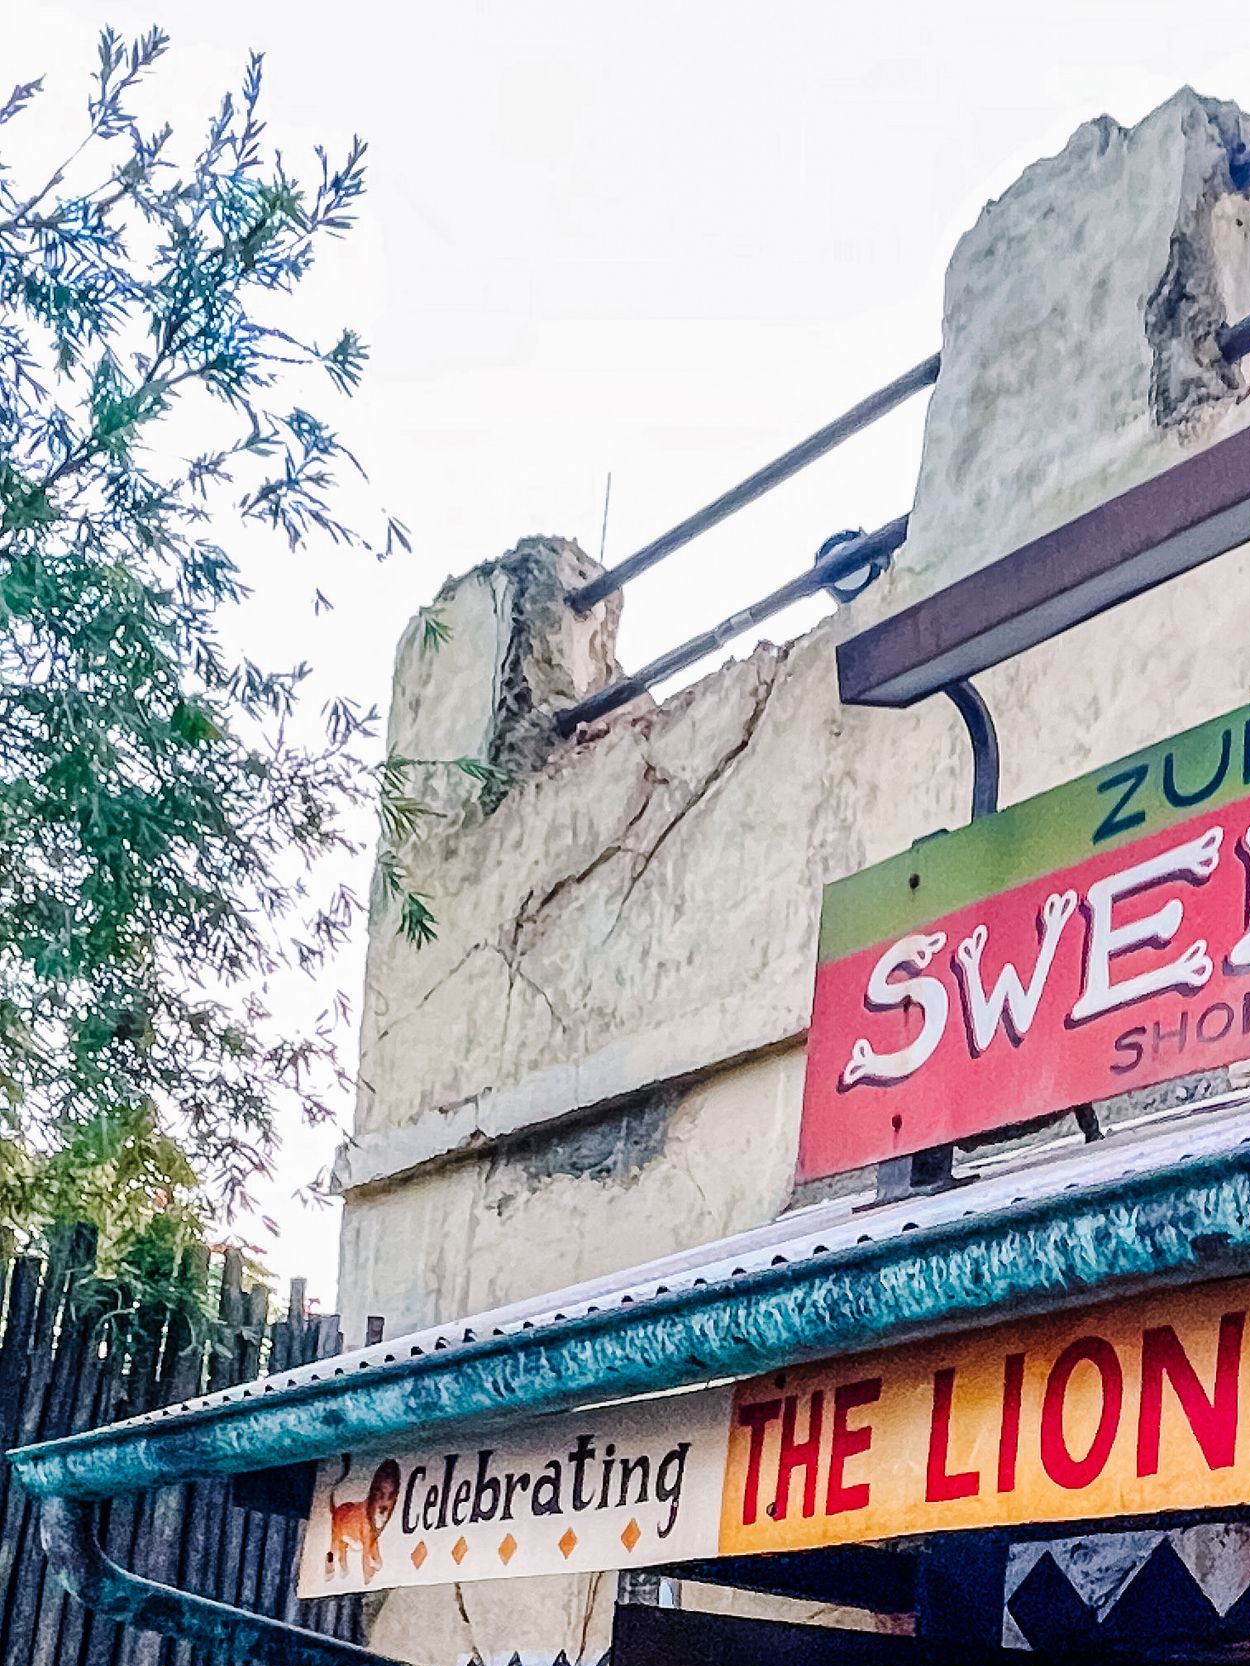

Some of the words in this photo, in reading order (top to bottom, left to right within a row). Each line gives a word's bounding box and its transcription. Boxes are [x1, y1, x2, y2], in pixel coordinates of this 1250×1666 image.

[402, 1434, 692, 1538] Celebrating
[739, 1377, 882, 1526] THE
[924, 1310, 1246, 1503] LION
